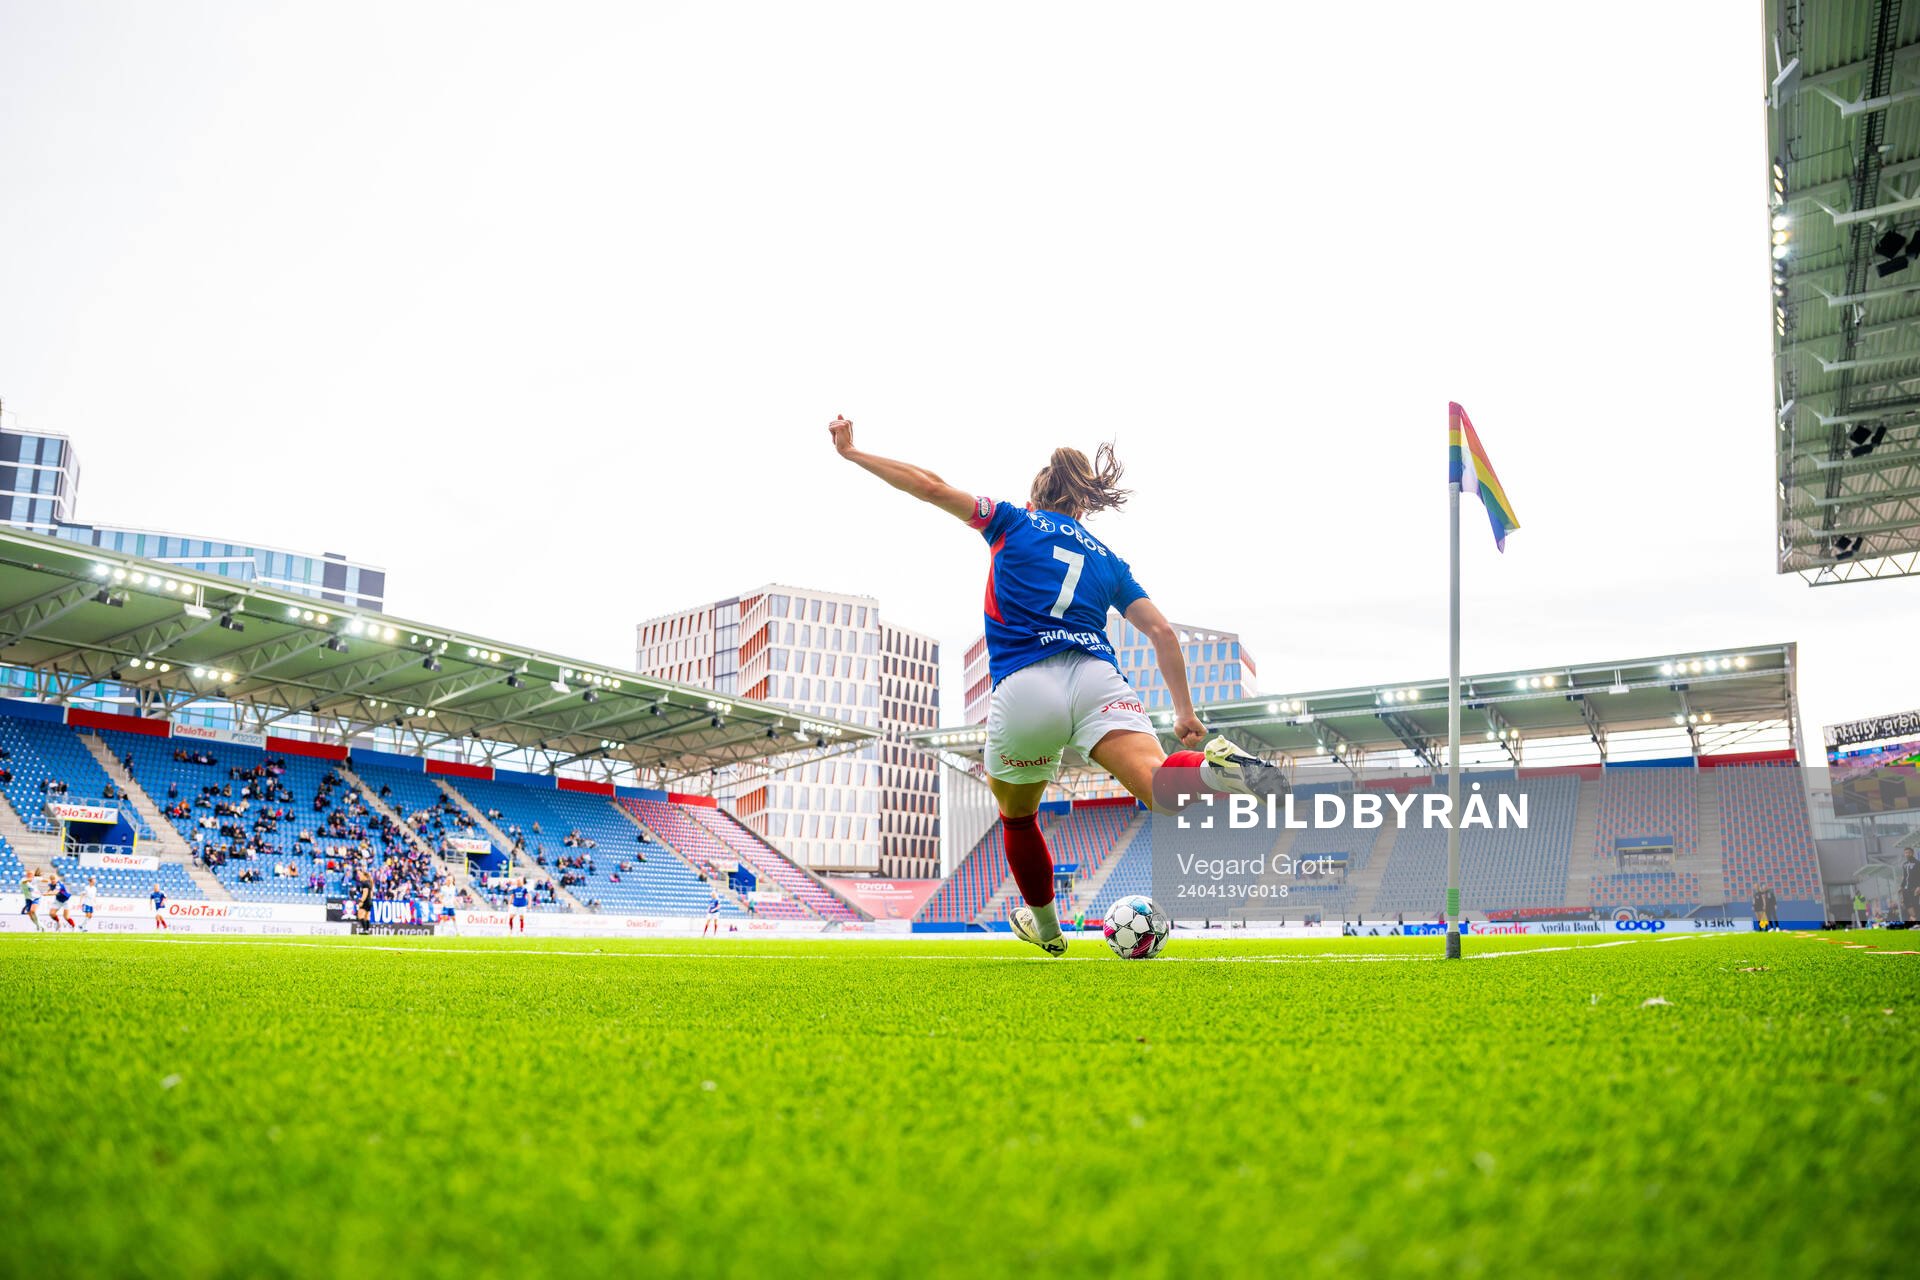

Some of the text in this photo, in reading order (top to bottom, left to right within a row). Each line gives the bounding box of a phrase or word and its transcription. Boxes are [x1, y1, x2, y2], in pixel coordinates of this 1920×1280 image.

[1060, 524, 1107, 557] OBOS
[1050, 545, 1085, 619] 7
[1883, 713, 1920, 731] aren
[1000, 754, 1053, 767] Scandic
[169, 904, 228, 917] OsloTaxi
[1573, 921, 1601, 932] Bank
[1615, 919, 1665, 932] coop
